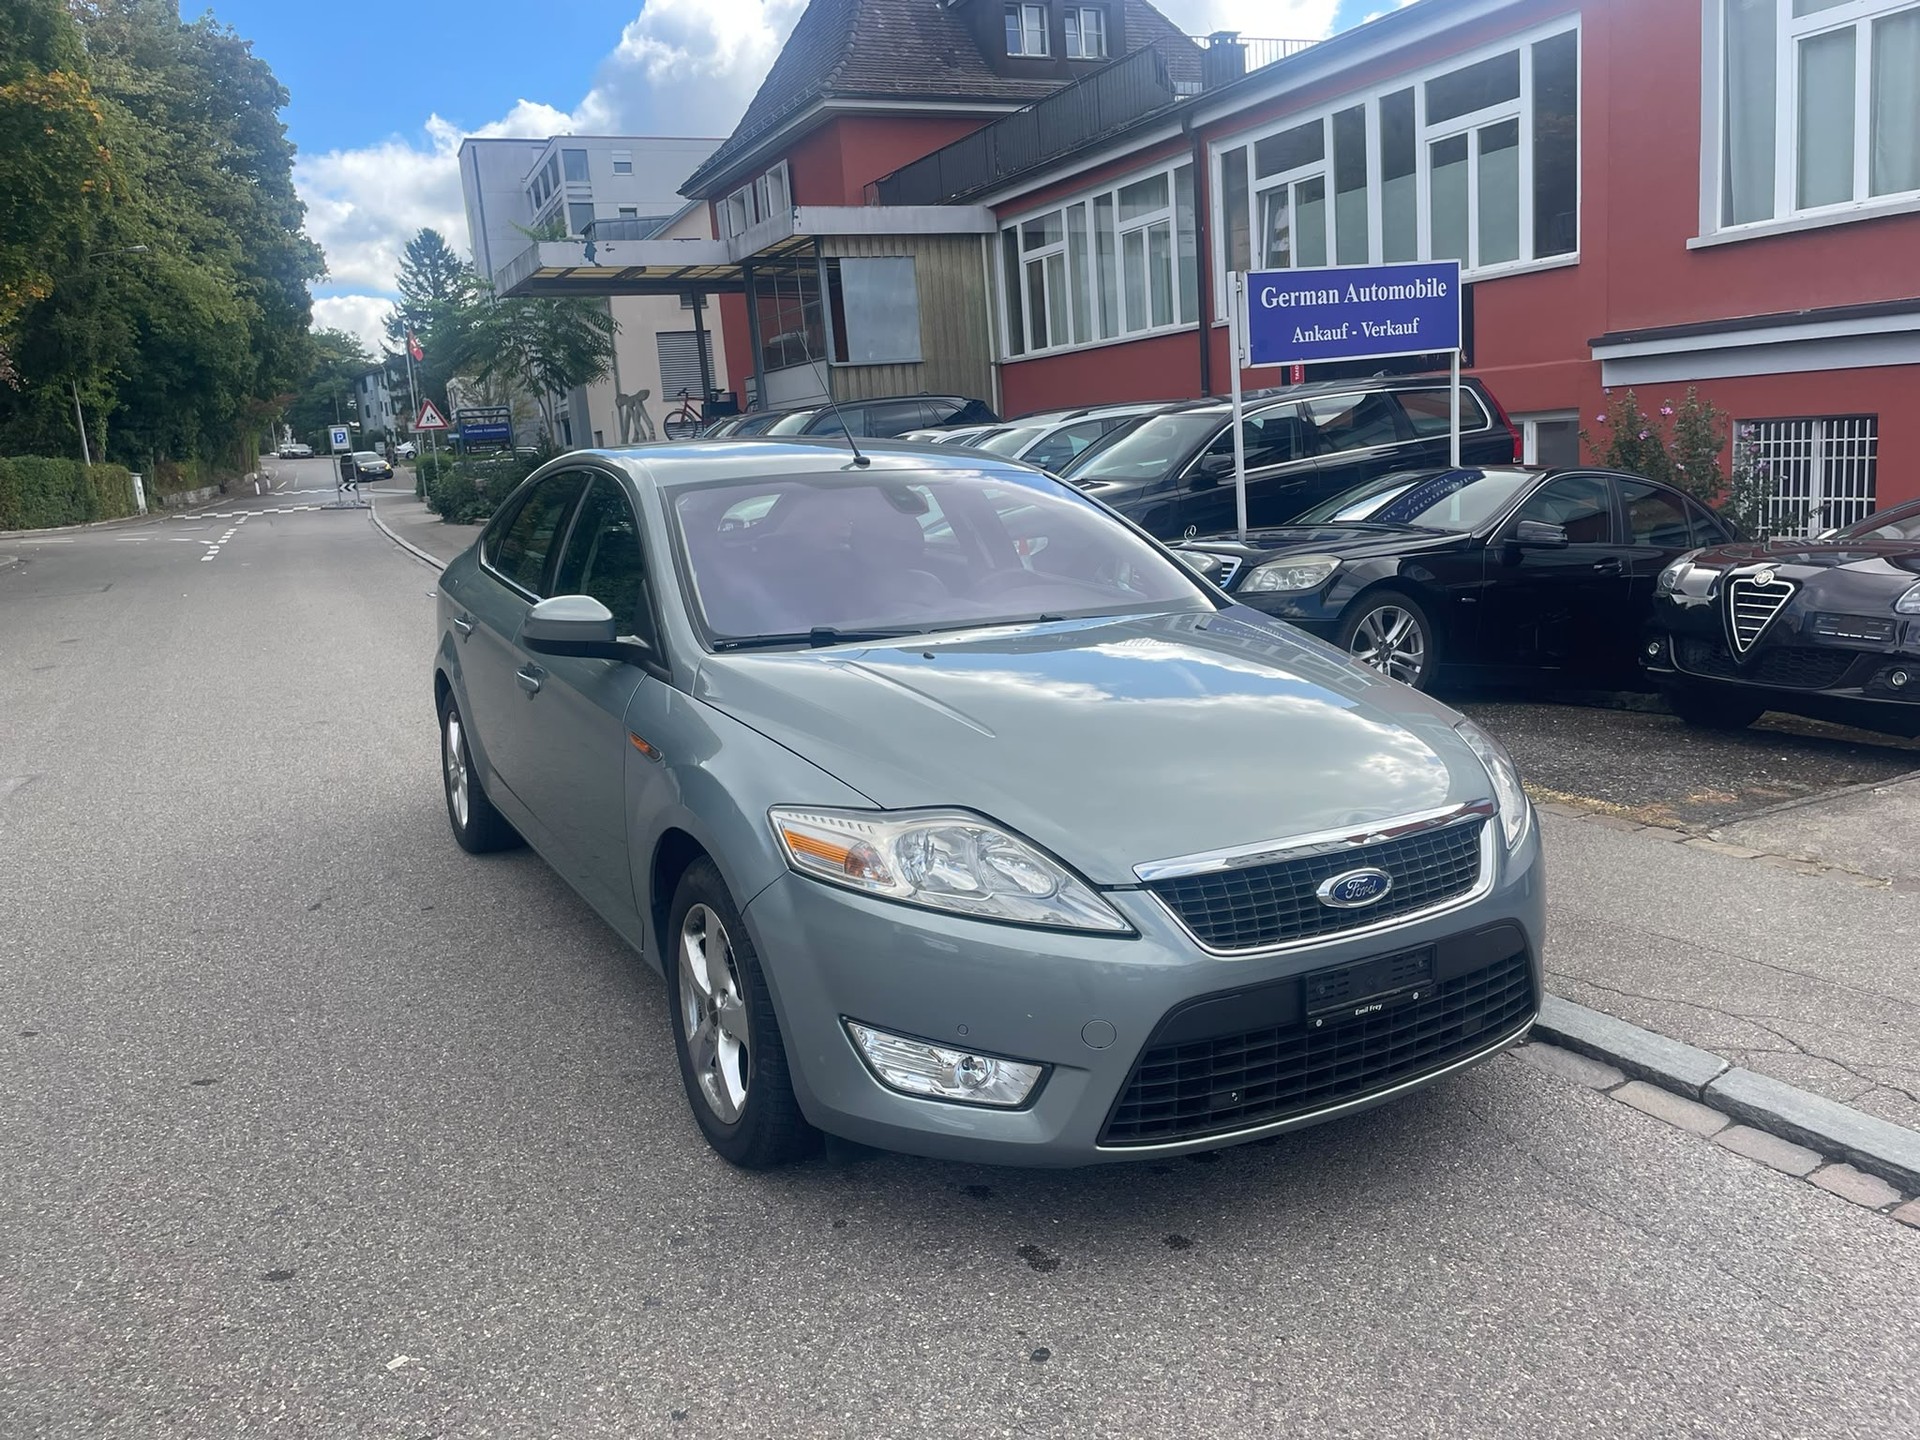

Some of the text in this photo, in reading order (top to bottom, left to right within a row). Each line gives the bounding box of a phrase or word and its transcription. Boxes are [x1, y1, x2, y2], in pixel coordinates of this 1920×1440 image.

[1260, 277, 1448, 309] German Automobile
[1291, 323, 1349, 343] Ankauf
[1360, 317, 1420, 338] Verkauf
[336, 433, 344, 443] P
[1345, 877, 1377, 899] Ford
[1355, 1003, 1383, 1016] Emil Frey
